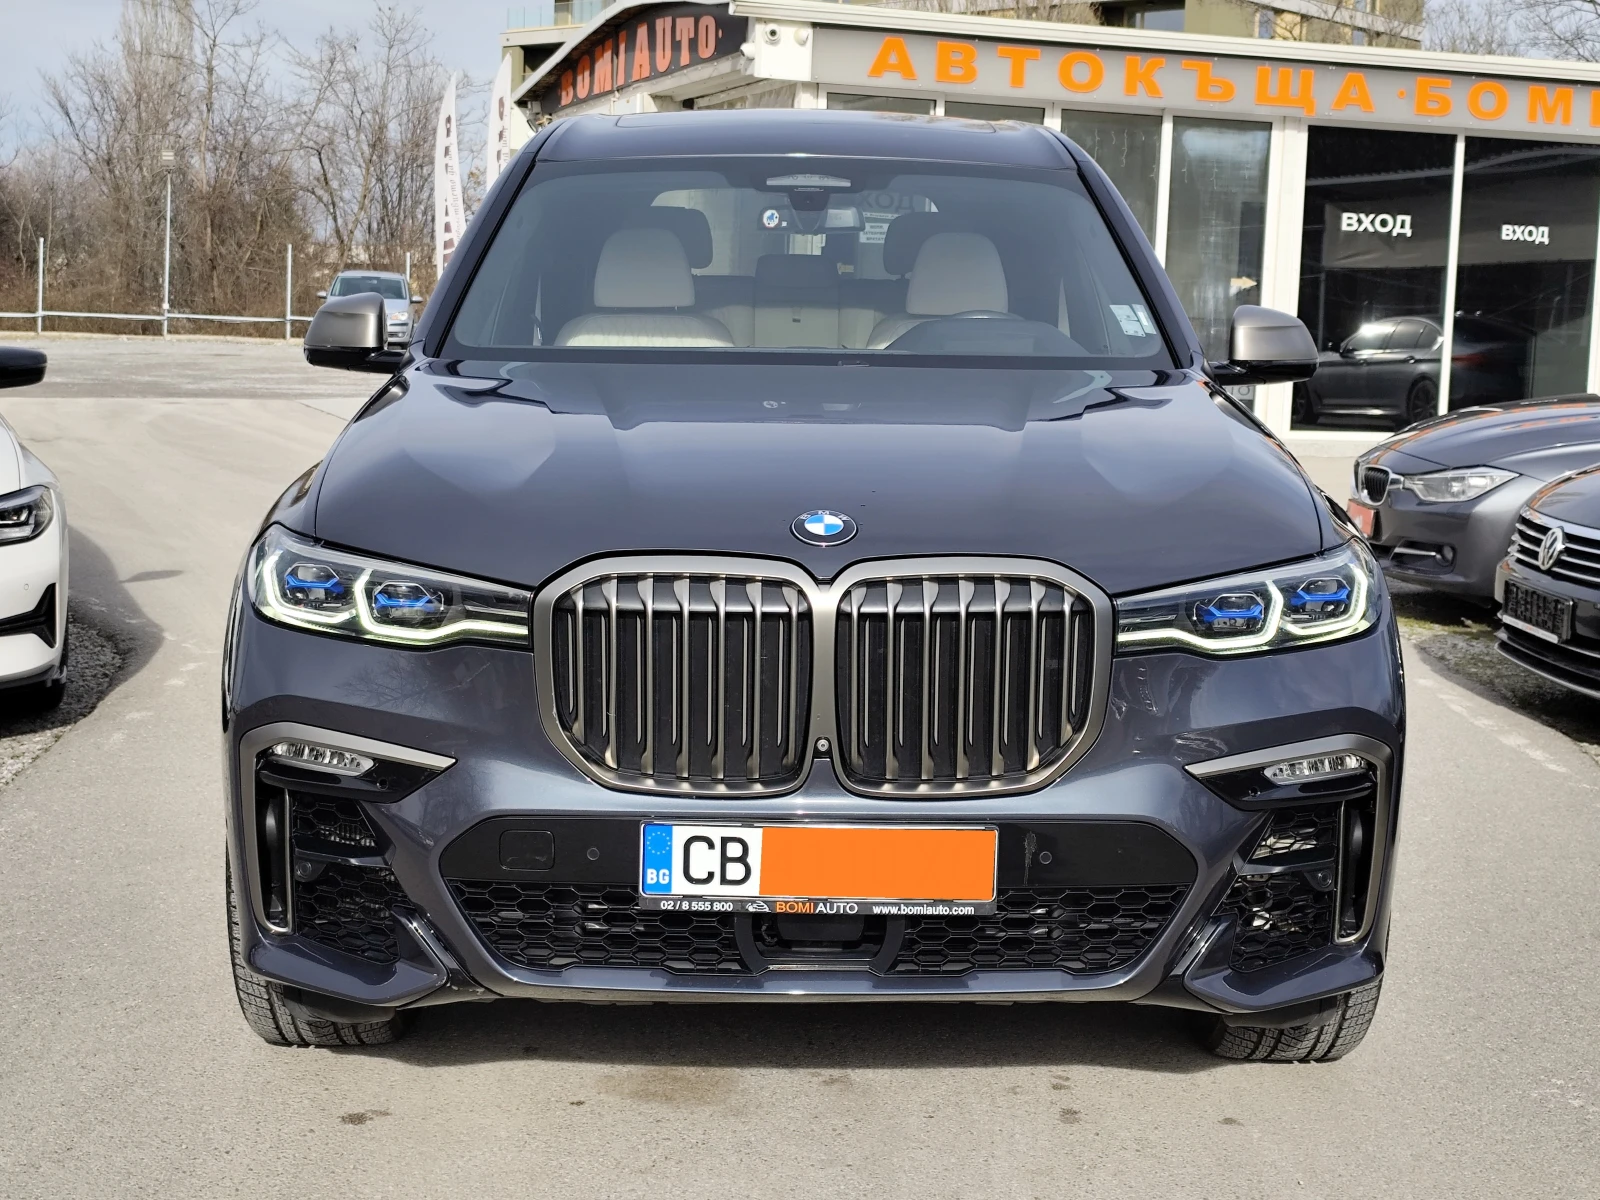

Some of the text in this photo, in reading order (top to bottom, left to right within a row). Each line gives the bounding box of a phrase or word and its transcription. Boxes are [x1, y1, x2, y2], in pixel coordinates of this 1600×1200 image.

[560, 15, 716, 107] BOMI AUTO
[1414, 76, 1600, 128] БОМ
[1341, 212, 1412, 237] ВХОД
[1501, 224, 1550, 245] ВХОД
[683, 835, 752, 886] CB
[646, 868, 670, 885] BG
[660, 901, 674, 910] 02
[682, 901, 689, 910] 8
[691, 901, 711, 911] 555
[713, 902, 733, 911] 800
[873, 904, 975, 915] www.bomiauto.com
